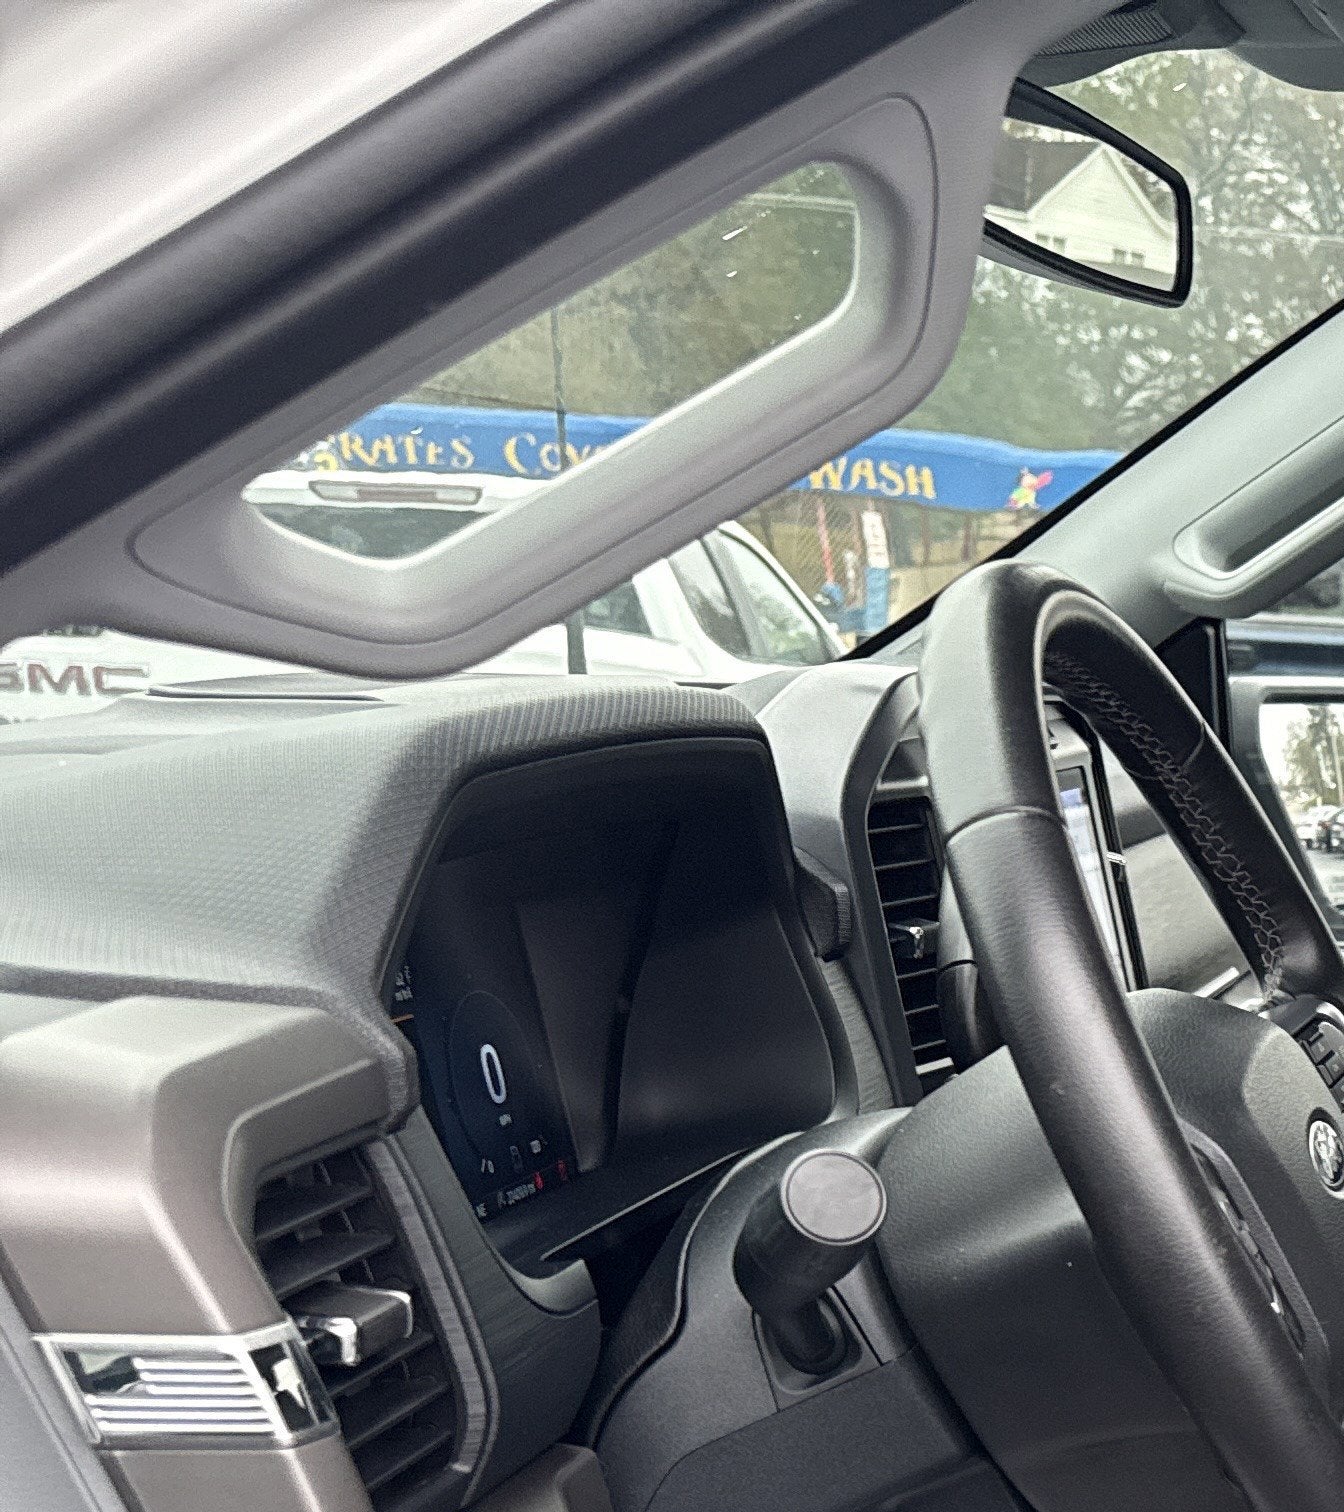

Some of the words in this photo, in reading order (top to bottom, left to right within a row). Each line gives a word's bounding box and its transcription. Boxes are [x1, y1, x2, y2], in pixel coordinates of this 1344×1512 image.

[328, 431, 475, 469] RATES
[808, 456, 937, 500] WASH
[480, 1043, 507, 1104] 0
